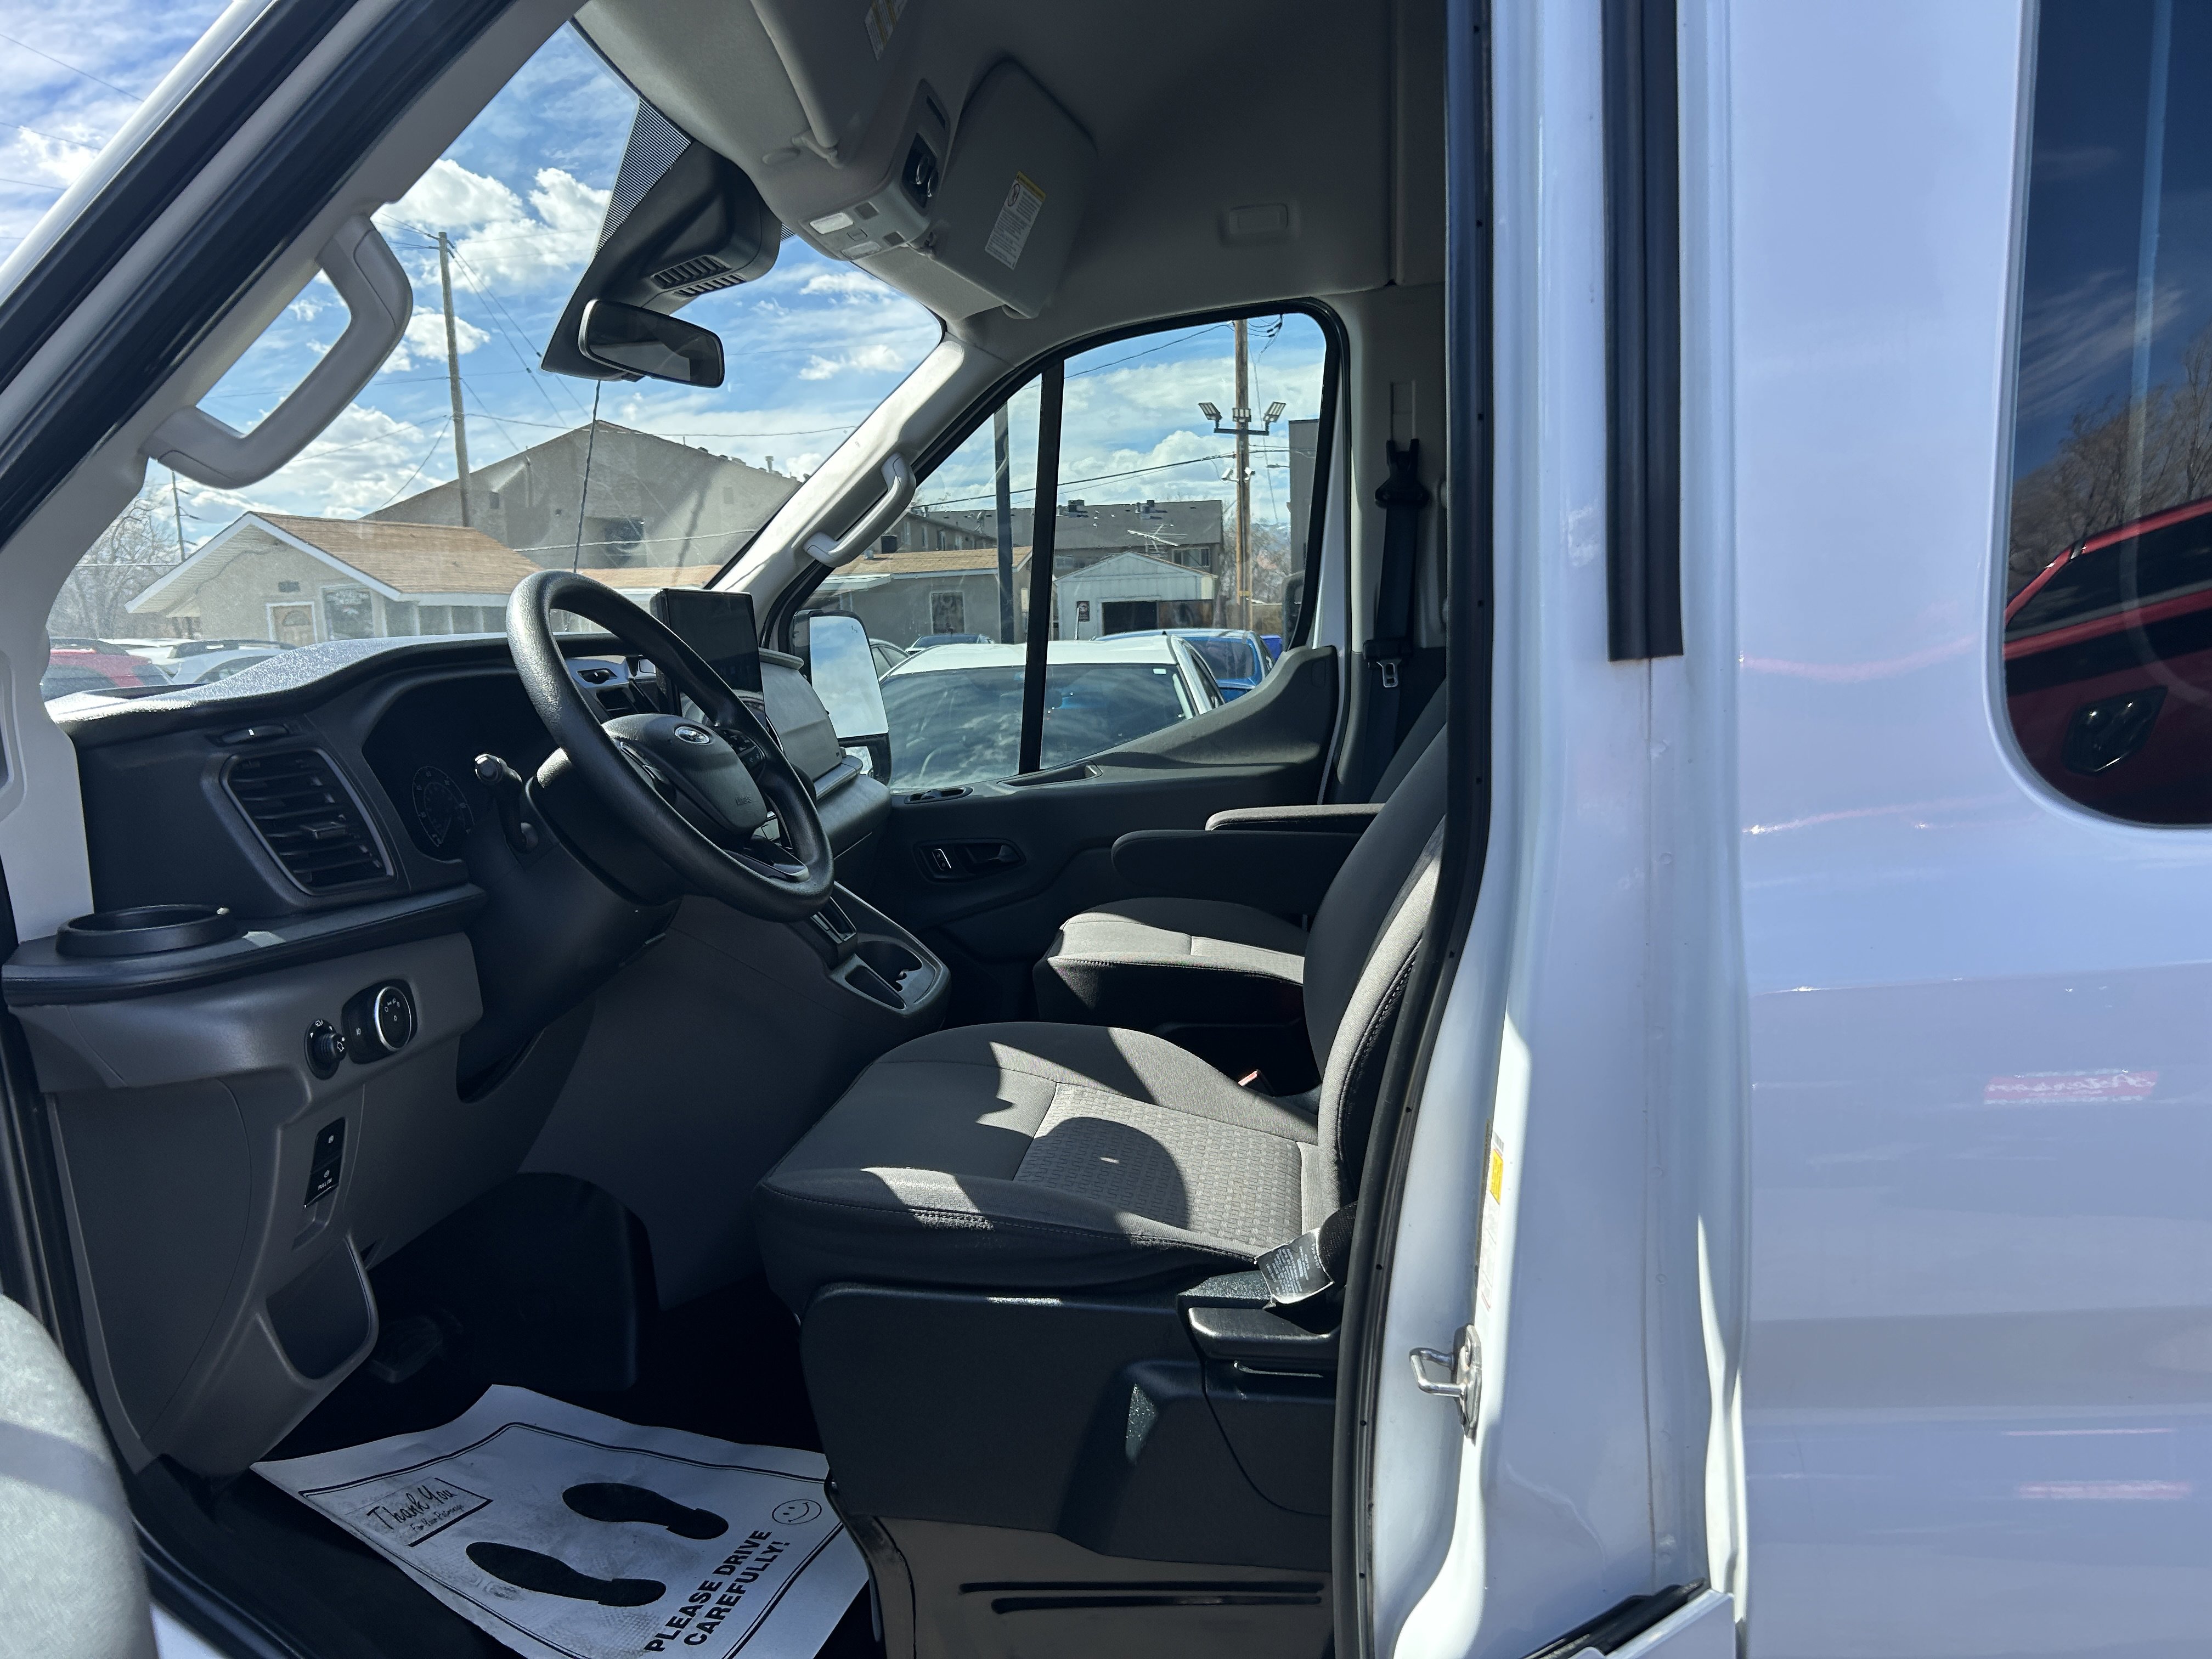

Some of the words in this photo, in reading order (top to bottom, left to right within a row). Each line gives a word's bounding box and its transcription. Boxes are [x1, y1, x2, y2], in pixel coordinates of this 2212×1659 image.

[366, 1493, 430, 1530] Thank
[417, 1485, 457, 1504] You
[643, 1580, 723, 1652] PLEASE
[712, 1530, 772, 1576] DRIVE
[684, 1541, 791, 1646] CAREFULLY!
